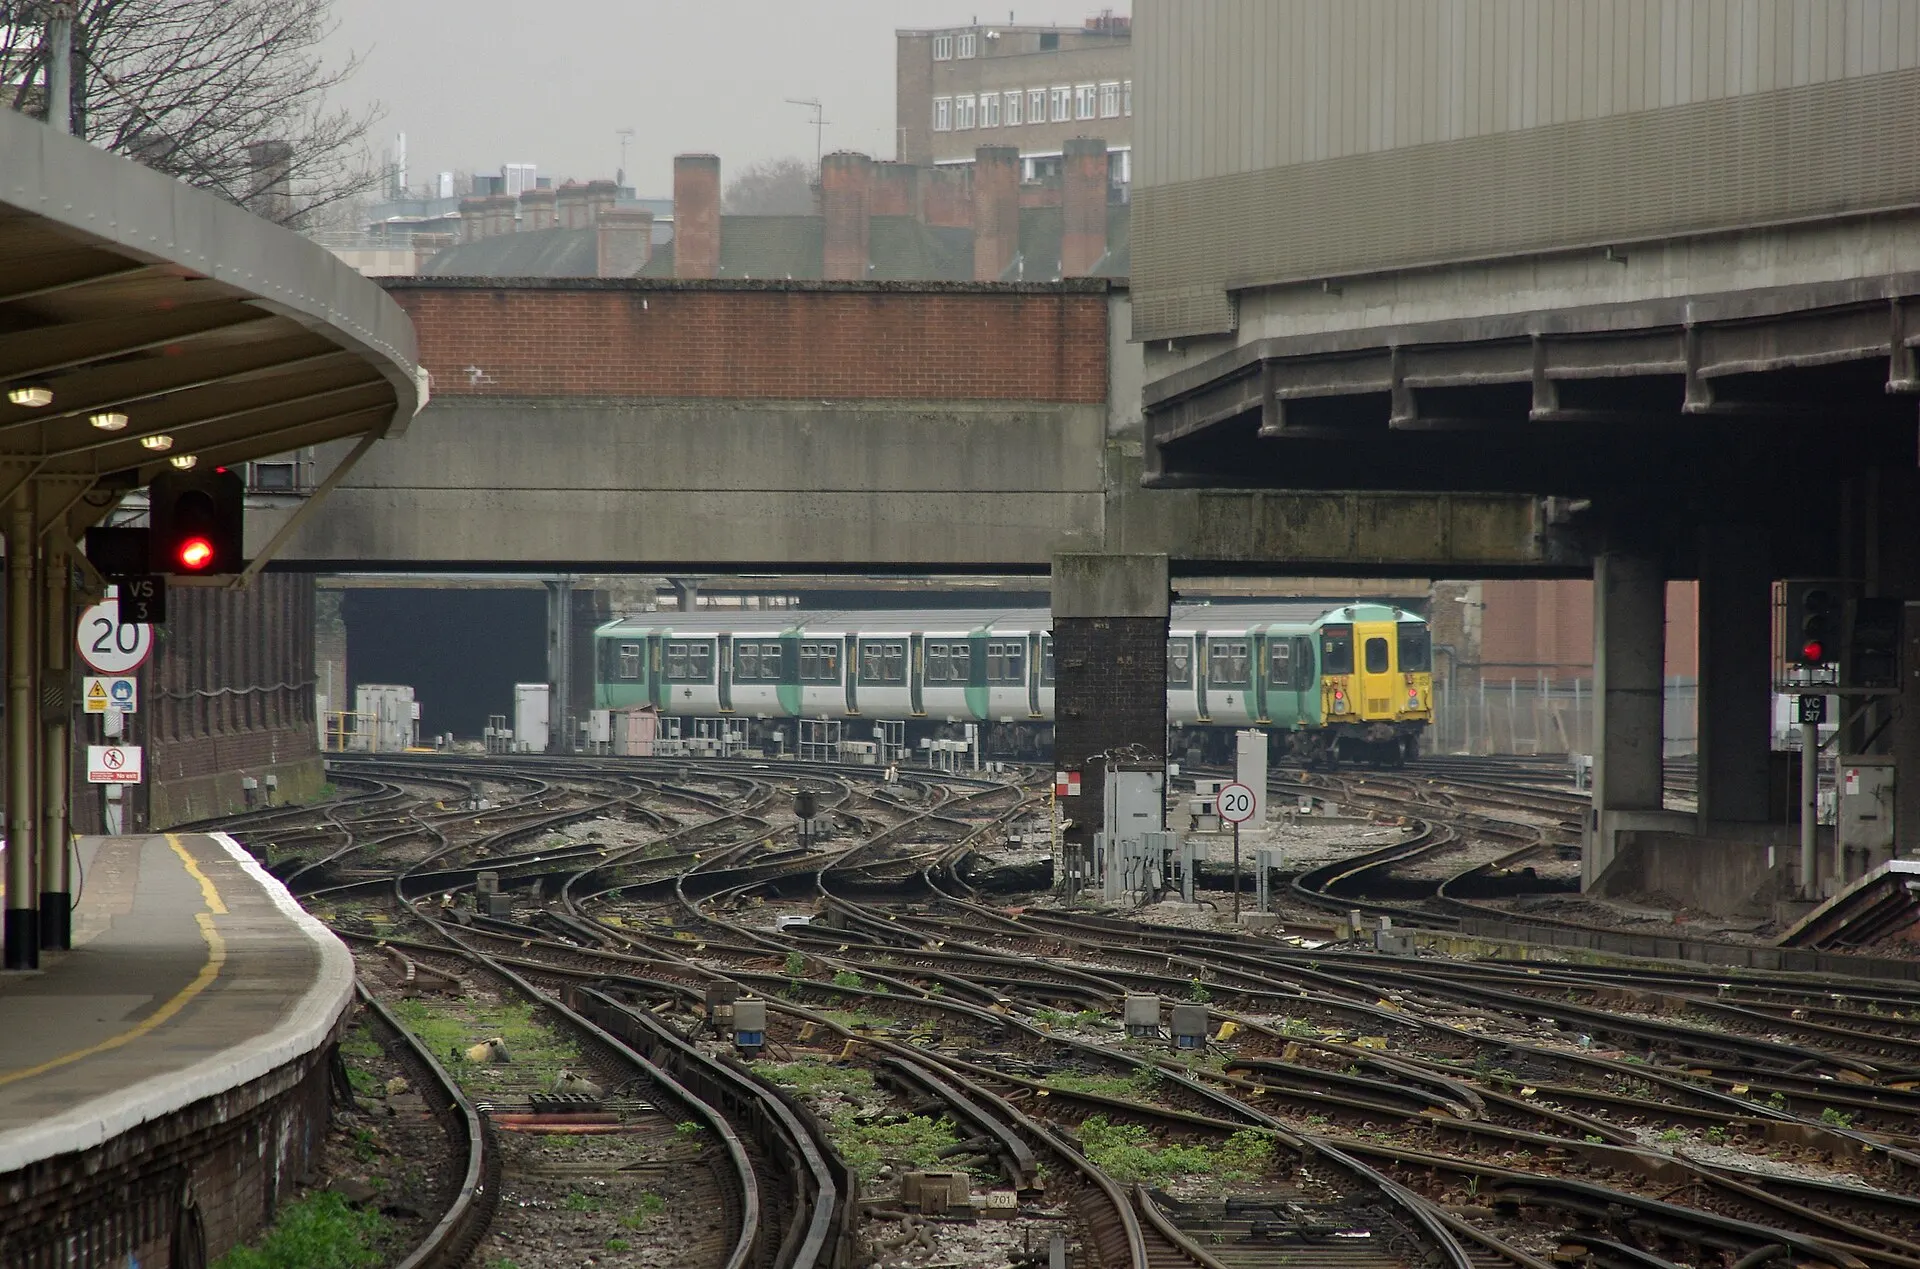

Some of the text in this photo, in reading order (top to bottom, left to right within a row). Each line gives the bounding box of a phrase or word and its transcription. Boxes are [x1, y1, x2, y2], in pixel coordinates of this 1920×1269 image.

[129, 581, 154, 598] VS
[137, 603, 148, 619] 3
[92, 617, 140, 654] 20
[1804, 698, 1820, 708] VC
[1804, 711, 1820, 722] 517
[1225, 794, 1249, 812] 20
[993, 1195, 1011, 1204] 701
